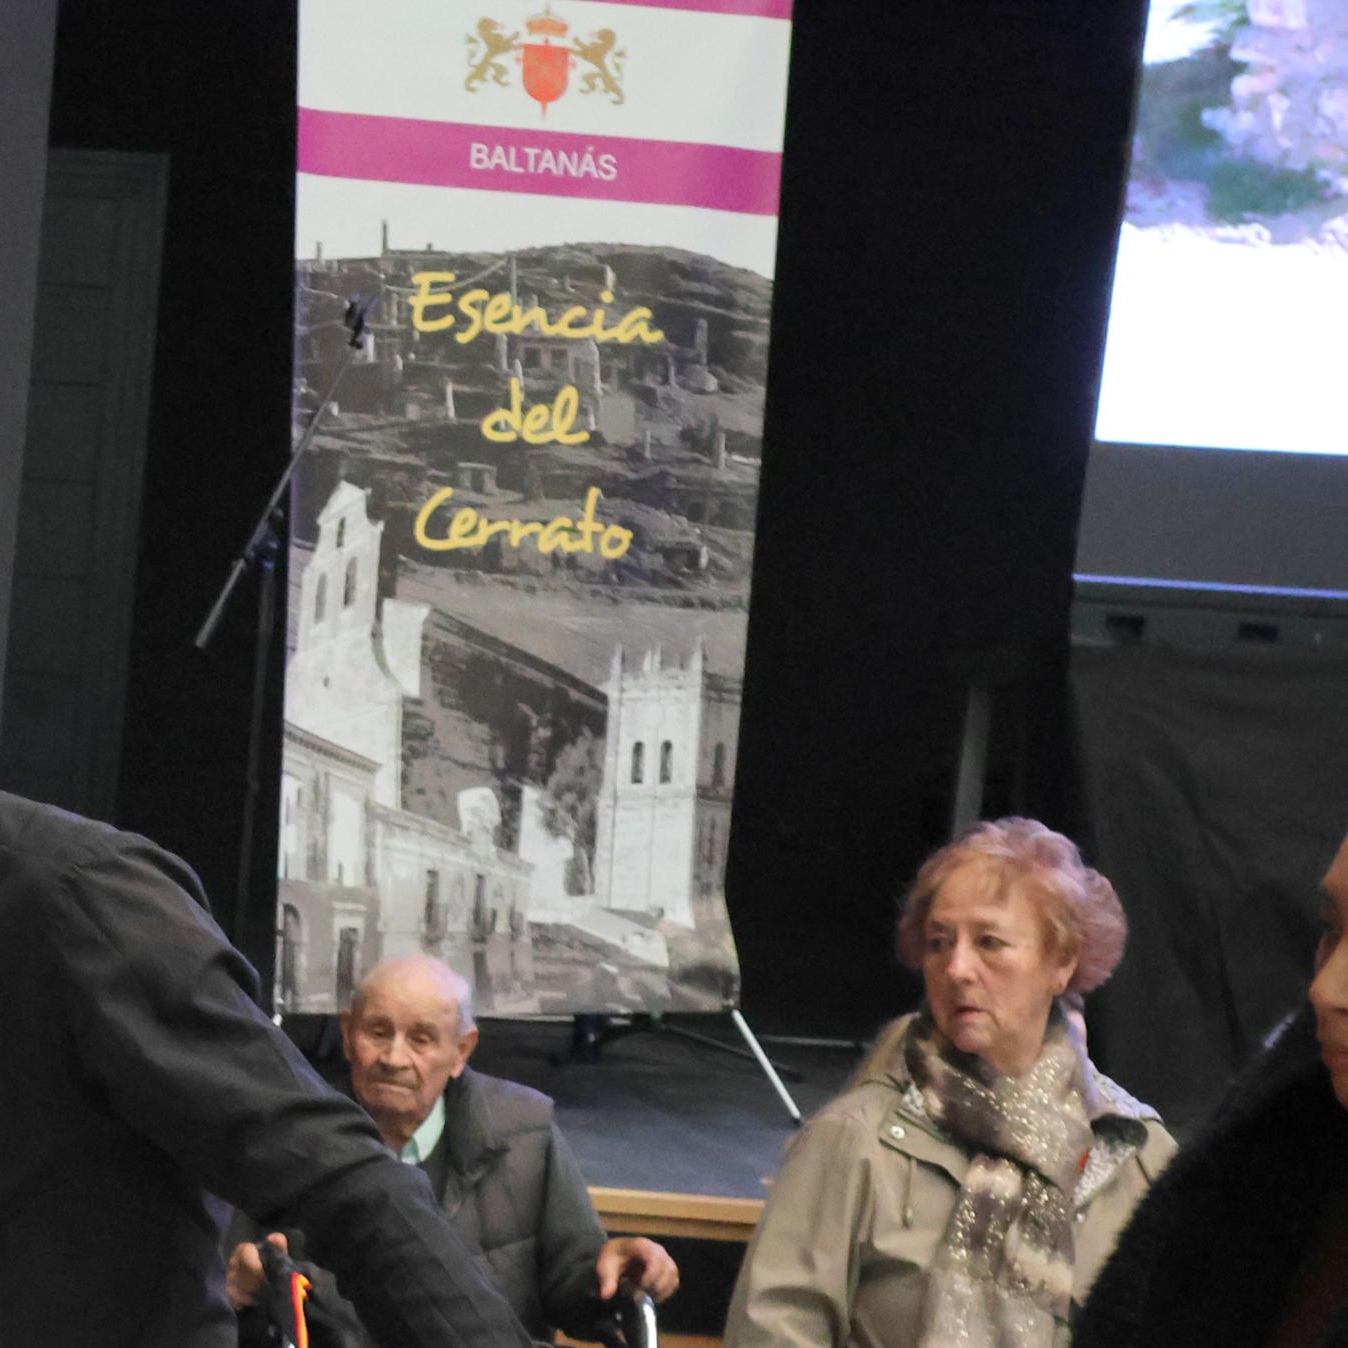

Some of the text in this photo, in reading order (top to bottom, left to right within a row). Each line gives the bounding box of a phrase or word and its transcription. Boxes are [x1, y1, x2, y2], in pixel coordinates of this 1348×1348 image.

[469, 143, 618, 181] BALTANÁS
[409, 271, 664, 344] Esencia
[482, 376, 590, 444] del
[414, 485, 634, 559] Cerrato
